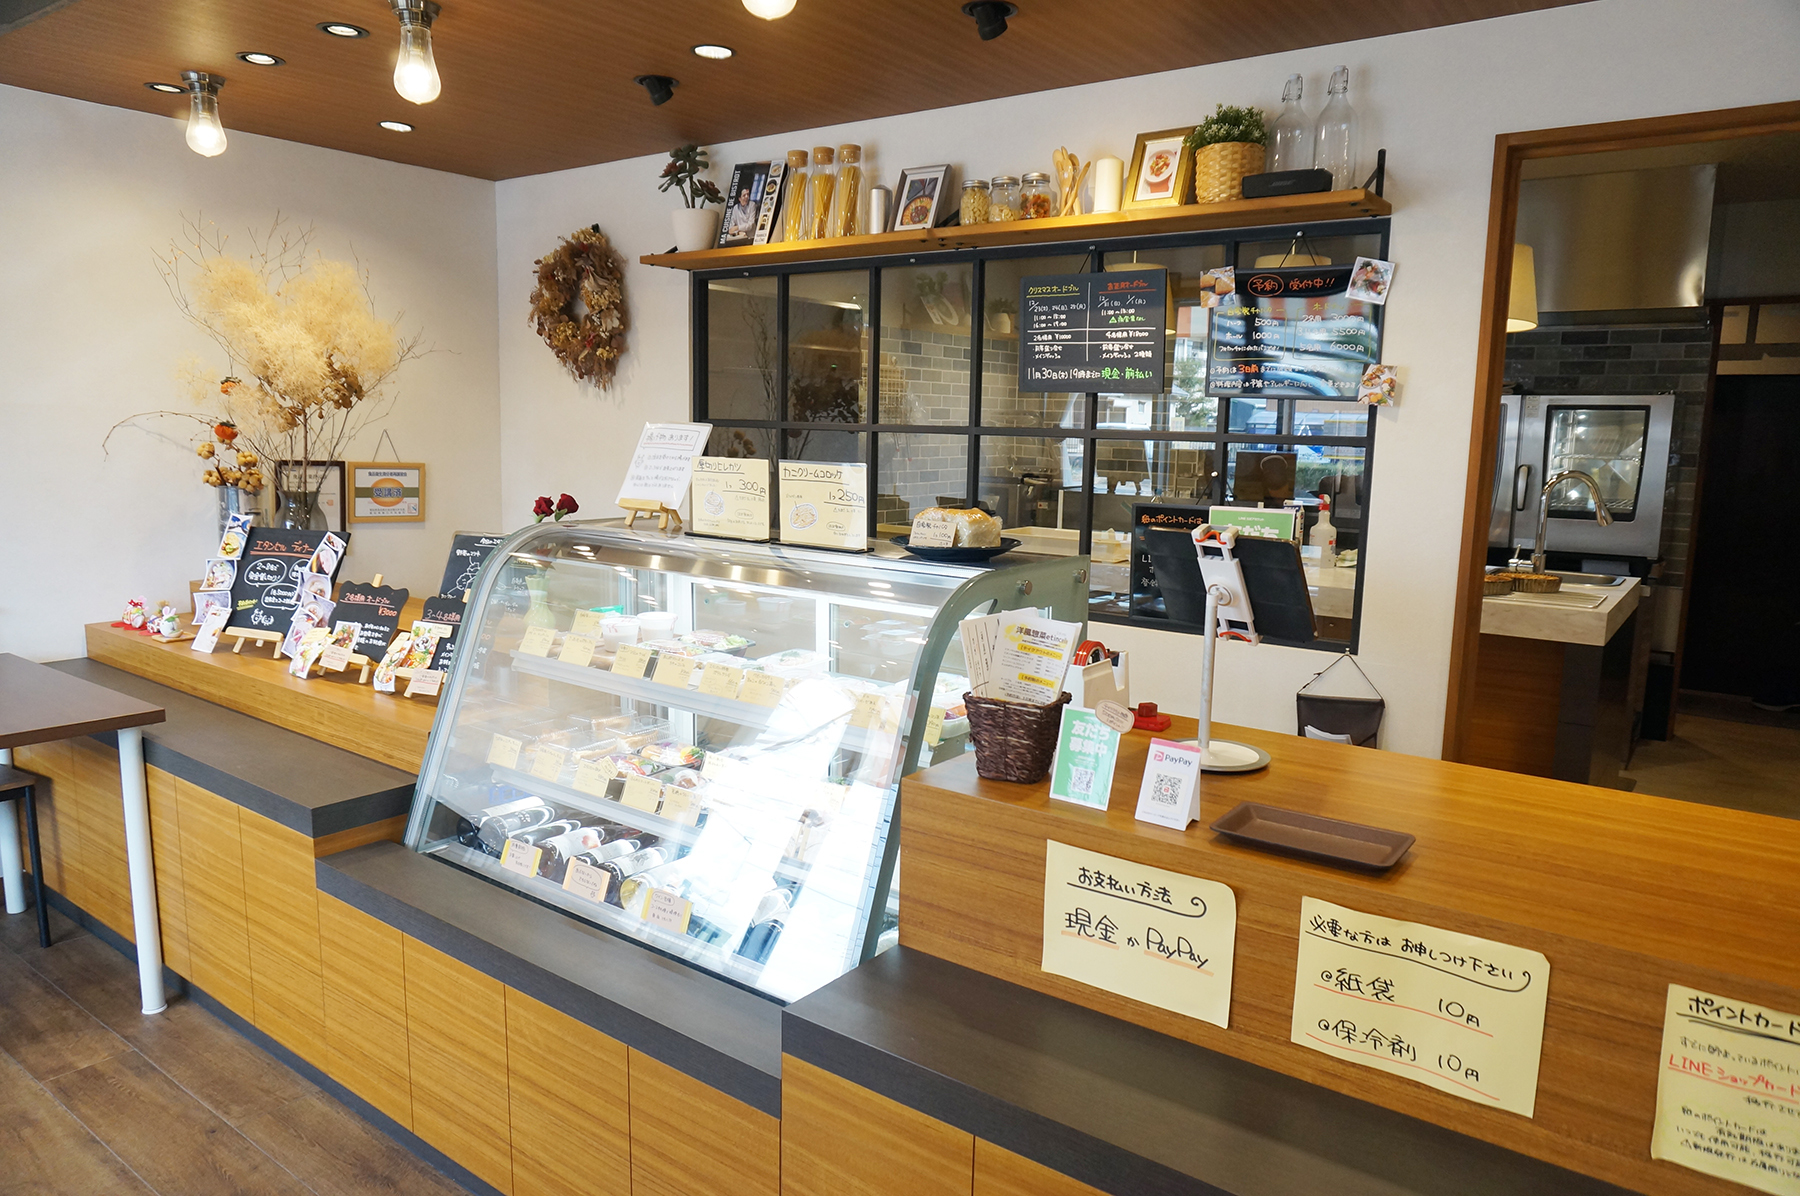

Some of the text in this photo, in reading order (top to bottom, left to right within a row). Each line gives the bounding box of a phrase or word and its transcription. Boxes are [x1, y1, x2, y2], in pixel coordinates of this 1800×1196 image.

[719, 171, 741, 245] MA CUISINE DE BISTROT
[1028, 283, 1080, 295] クリスマスオードブル
[1252, 278, 1279, 293] 予約
[1254, 317, 1280, 327] 500円
[1225, 331, 1280, 341] ホール 1000円
[1332, 327, 1366, 336] 5500円
[1329, 341, 1365, 353] 6000円
[697, 459, 742, 472] 厚切りヒレカツ
[783, 466, 843, 480] カニクリームコロッケ
[738, 479, 766, 495] 300円
[837, 488, 865, 504] 250円
[1141, 514, 1204, 525] 紙のポイントカードは
[1224, 524, 1280, 539] だち
[1071, 719, 1111, 741] 友だち
[1069, 736, 1109, 757] 募集中
[1164, 753, 1194, 768] PayPay
[1078, 866, 1173, 905] お支払い方法
[1065, 907, 1119, 944] 現金
[1146, 926, 1208, 970] PayPay
[1309, 914, 1514, 980] 必要な方は お申しつけ下さい
[1437, 997, 1481, 1028] 10円
[1437, 1053, 1481, 1082] 10円
